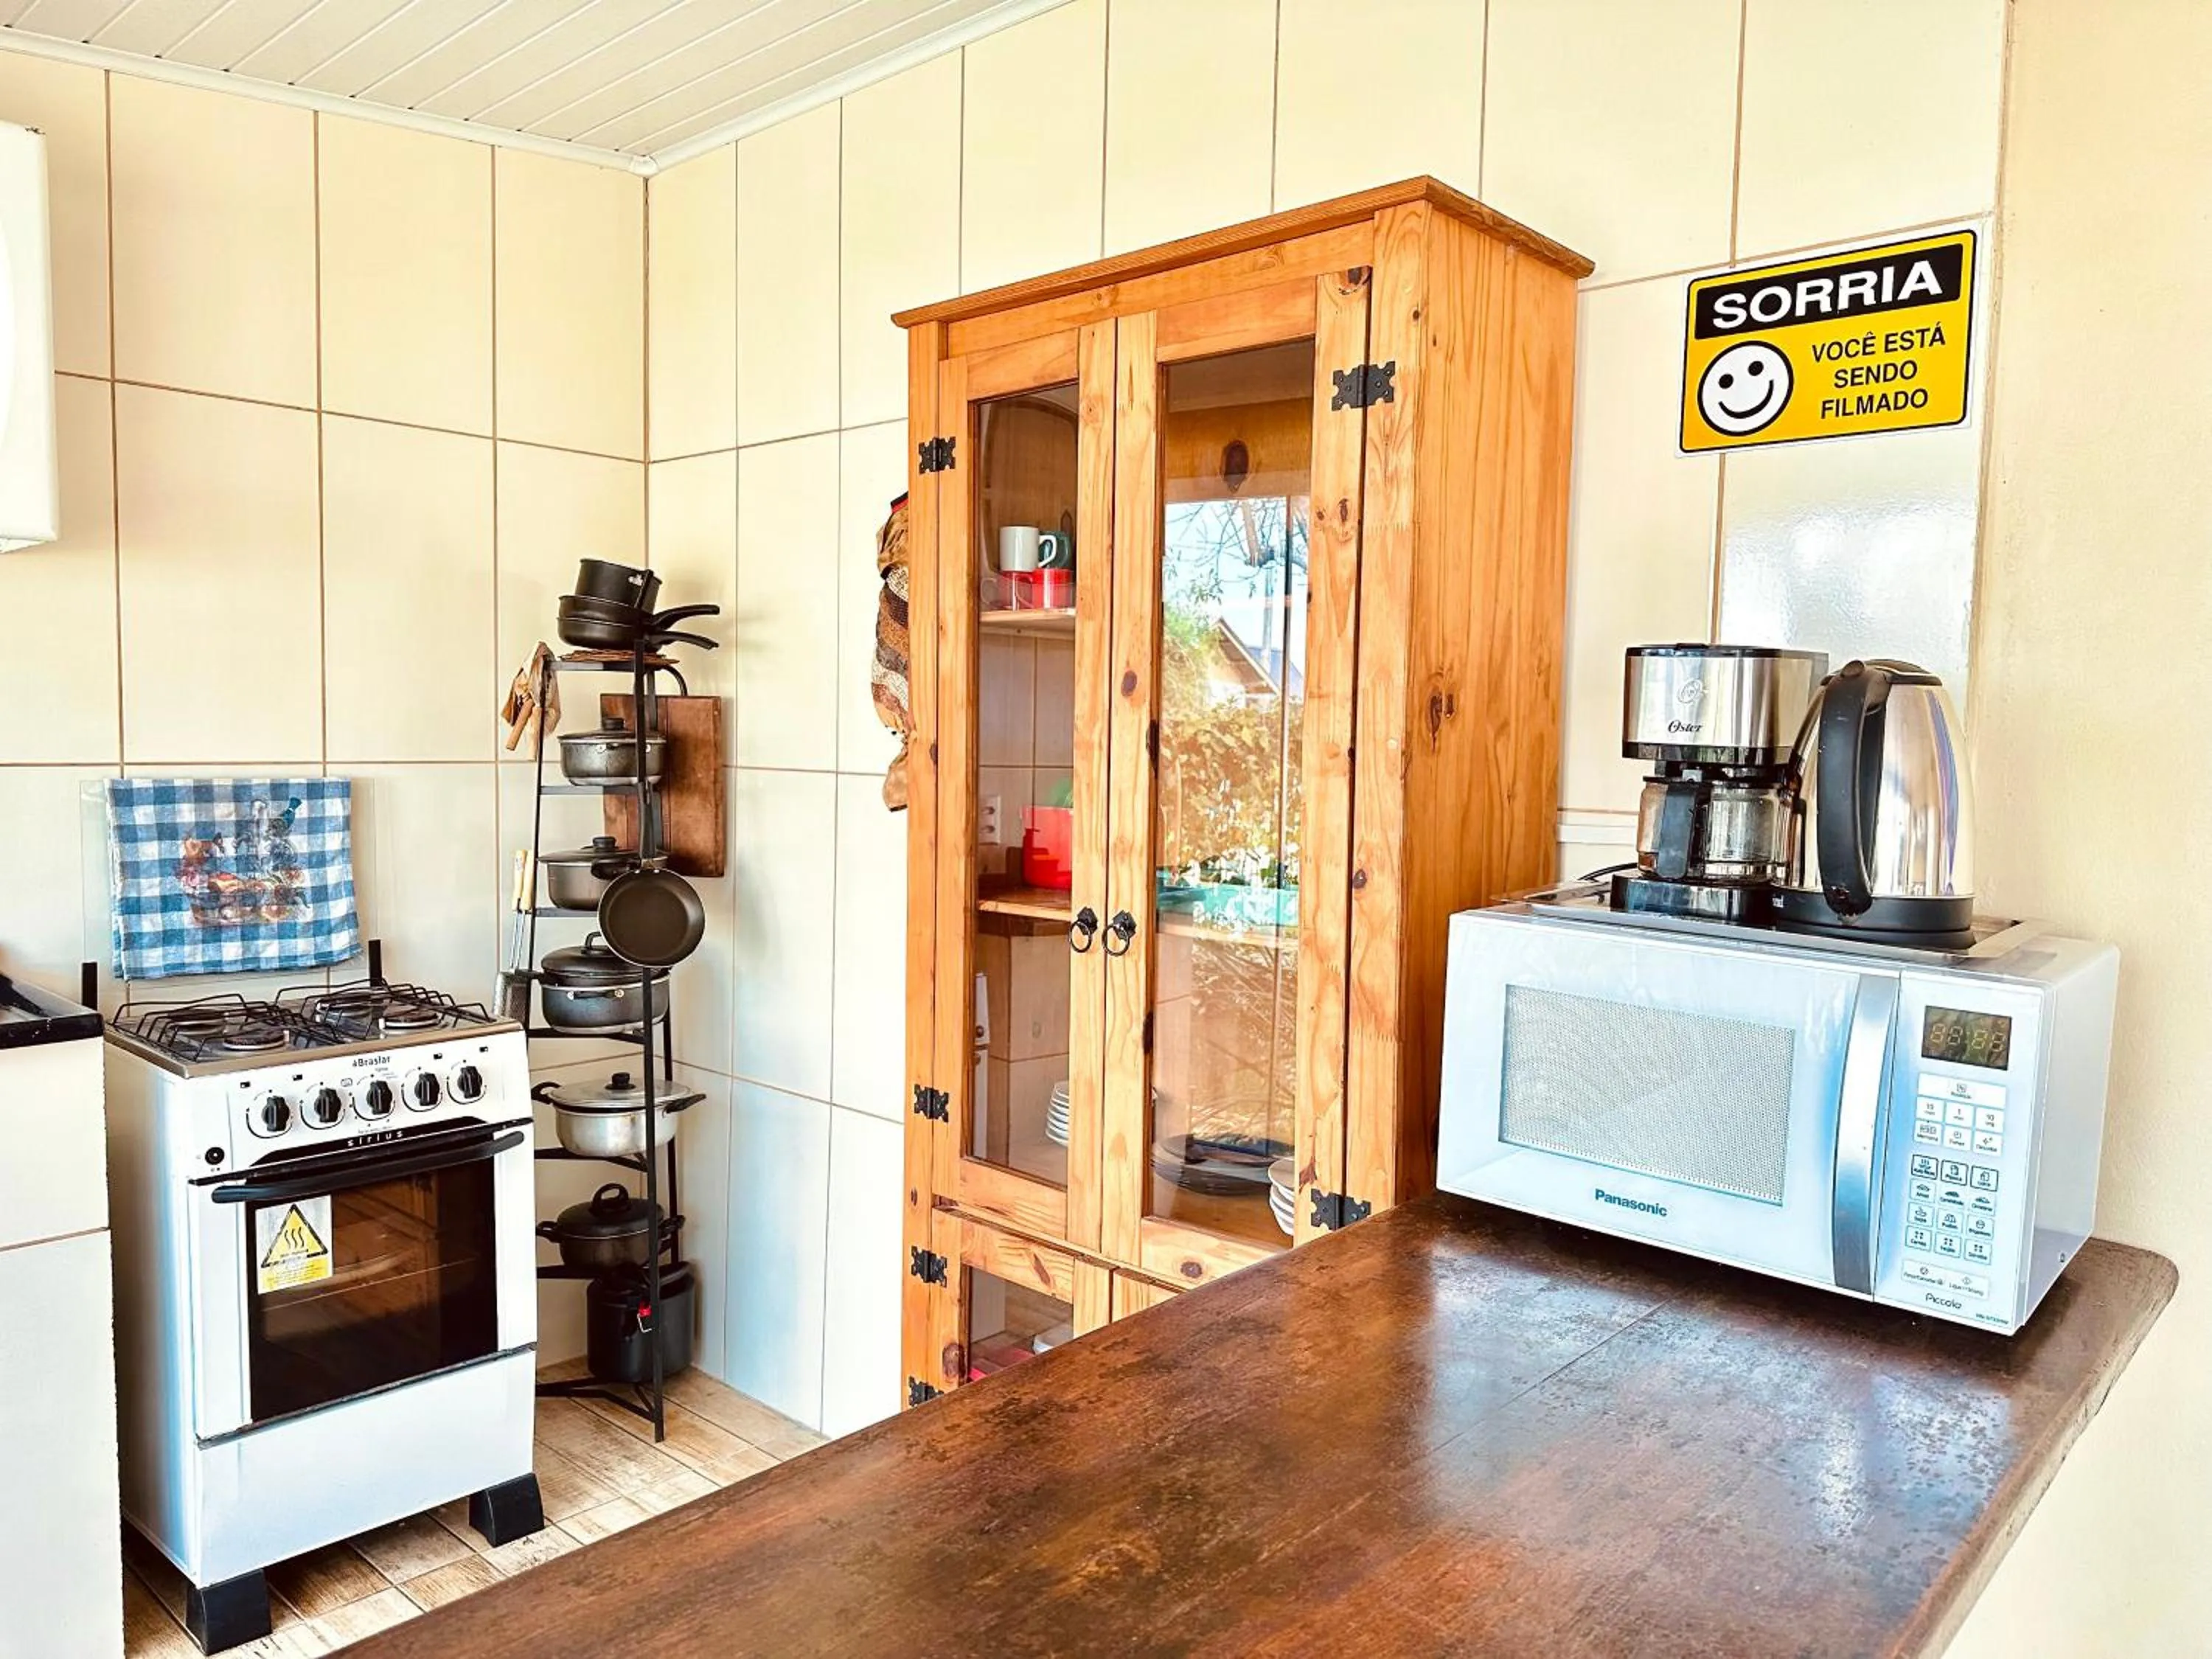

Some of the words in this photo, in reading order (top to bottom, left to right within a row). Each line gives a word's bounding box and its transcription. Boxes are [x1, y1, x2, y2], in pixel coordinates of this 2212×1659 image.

[1712, 260, 1943, 330] SORRIA
[1811, 331, 1877, 363] VOCÊ
[1884, 321, 1947, 353] ESTÁ
[1834, 360, 1918, 389] SENDO
[1820, 389, 1929, 420] FILMADO
[1667, 719, 1703, 734] Oster
[1594, 1188, 1668, 1217] Panasonic
[1924, 1292, 1963, 1310] Piccolo
